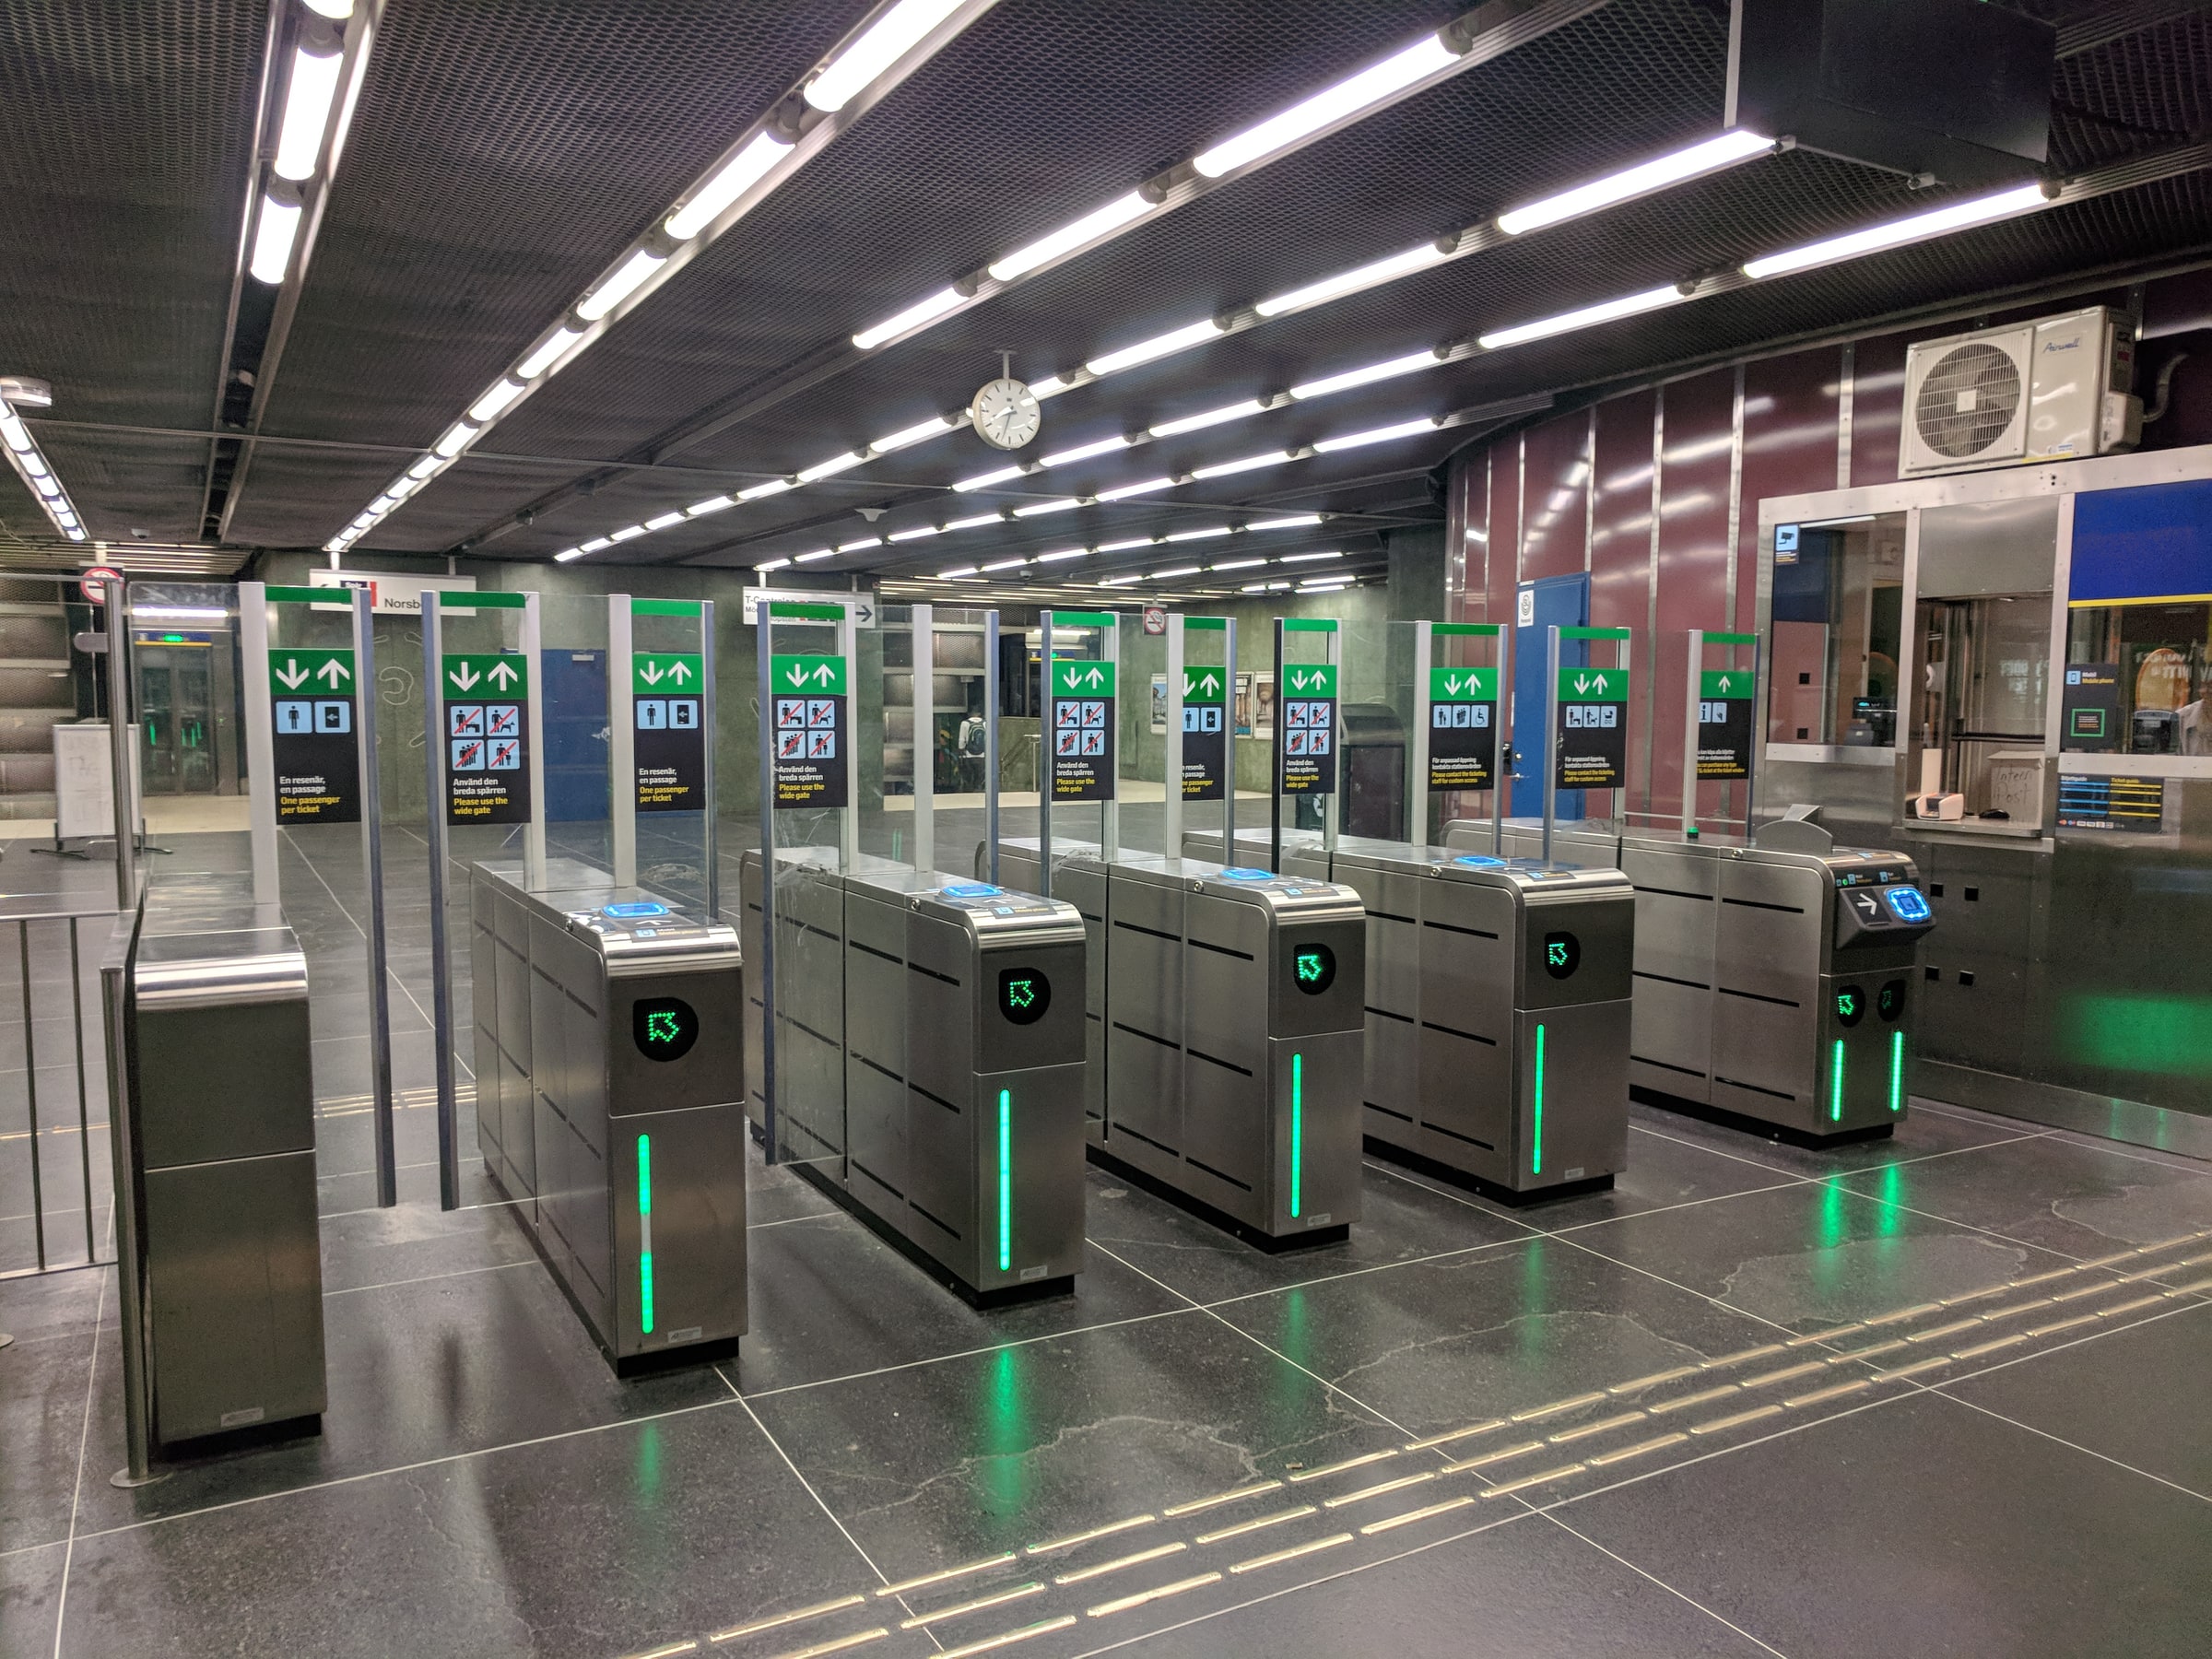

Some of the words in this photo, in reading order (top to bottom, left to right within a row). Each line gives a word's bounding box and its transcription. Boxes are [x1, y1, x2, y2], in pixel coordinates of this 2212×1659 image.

[384, 598, 422, 609] Norsb
[279, 776, 291, 784] En
[292, 775, 326, 784] resenär,
[292, 785, 326, 794] passage
[280, 796, 297, 804] One
[299, 796, 340, 805] passenger
[281, 807, 295, 816] per
[474, 807, 491, 815] gate
